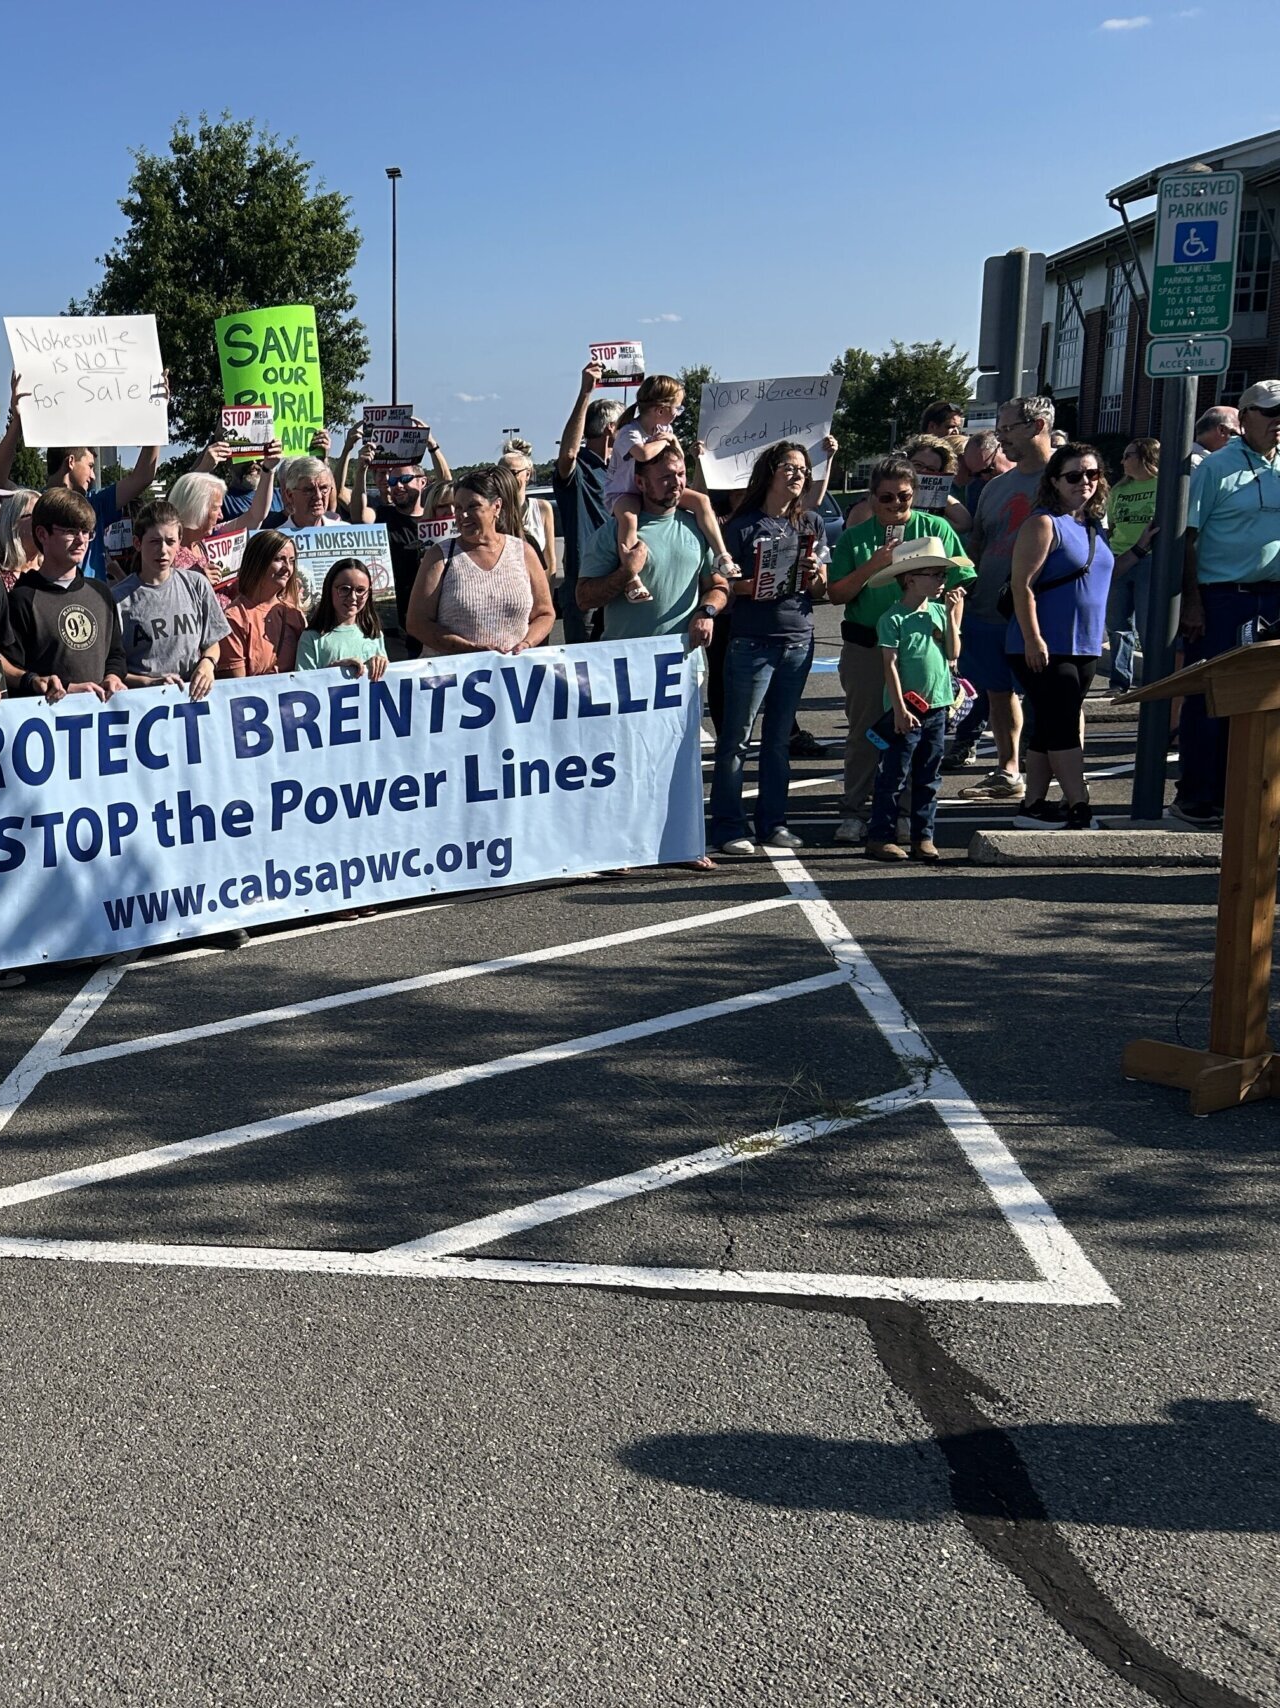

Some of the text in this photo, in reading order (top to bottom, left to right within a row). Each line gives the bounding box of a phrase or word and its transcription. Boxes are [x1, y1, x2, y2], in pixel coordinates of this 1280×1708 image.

[1164, 180, 1235, 199] RESERVED
[1168, 201, 1228, 219] PARKING
[1175, 265, 1211, 274] UNLAWFUL
[1164, 275, 1195, 285] PARKING
[1207, 274, 1222, 282] THIS
[1158, 284, 1226, 295] SPACE IS SUBJECT
[1167, 297, 1176, 305] TO
[1186, 295, 1203, 304] FINE
[1206, 294, 1215, 303] OF
[1165, 307, 1184, 316] $100
[1160, 316, 1219, 327] TOW AWAY ZONE
[224, 323, 317, 368] SAVE
[591, 347, 617, 361] STOP
[620, 346, 636, 354] MEGA
[1175, 346, 1202, 358] VAN
[53, 348, 128, 374] is NOT
[1159, 358, 1216, 370] ACCESSIBLE
[263, 366, 309, 386] OUR
[33, 384, 65, 410] for
[709, 387, 749, 410] YOUR
[223, 410, 268, 427] STOP MEGA
[363, 410, 387, 421] STOP
[281, 426, 317, 452] AND
[372, 430, 400, 443] STOP
[403, 431, 421, 439] MEGA
[705, 419, 817, 451] Created this
[921, 477, 943, 486] MEGA
[420, 522, 448, 539] STOP
[208, 539, 232, 559] STOP
[314, 530, 387, 550] NOKESVILLE!
[761, 549, 772, 569] MEGA
[758, 571, 776, 598] STOP
[133, 613, 202, 648] ARMY
[230, 651, 684, 760] BRENTSVILLE
[152, 790, 254, 848] the
[271, 769, 447, 832] Power
[464, 747, 616, 803] Lines
[104, 836, 513, 932] www.cabsapwc.org
